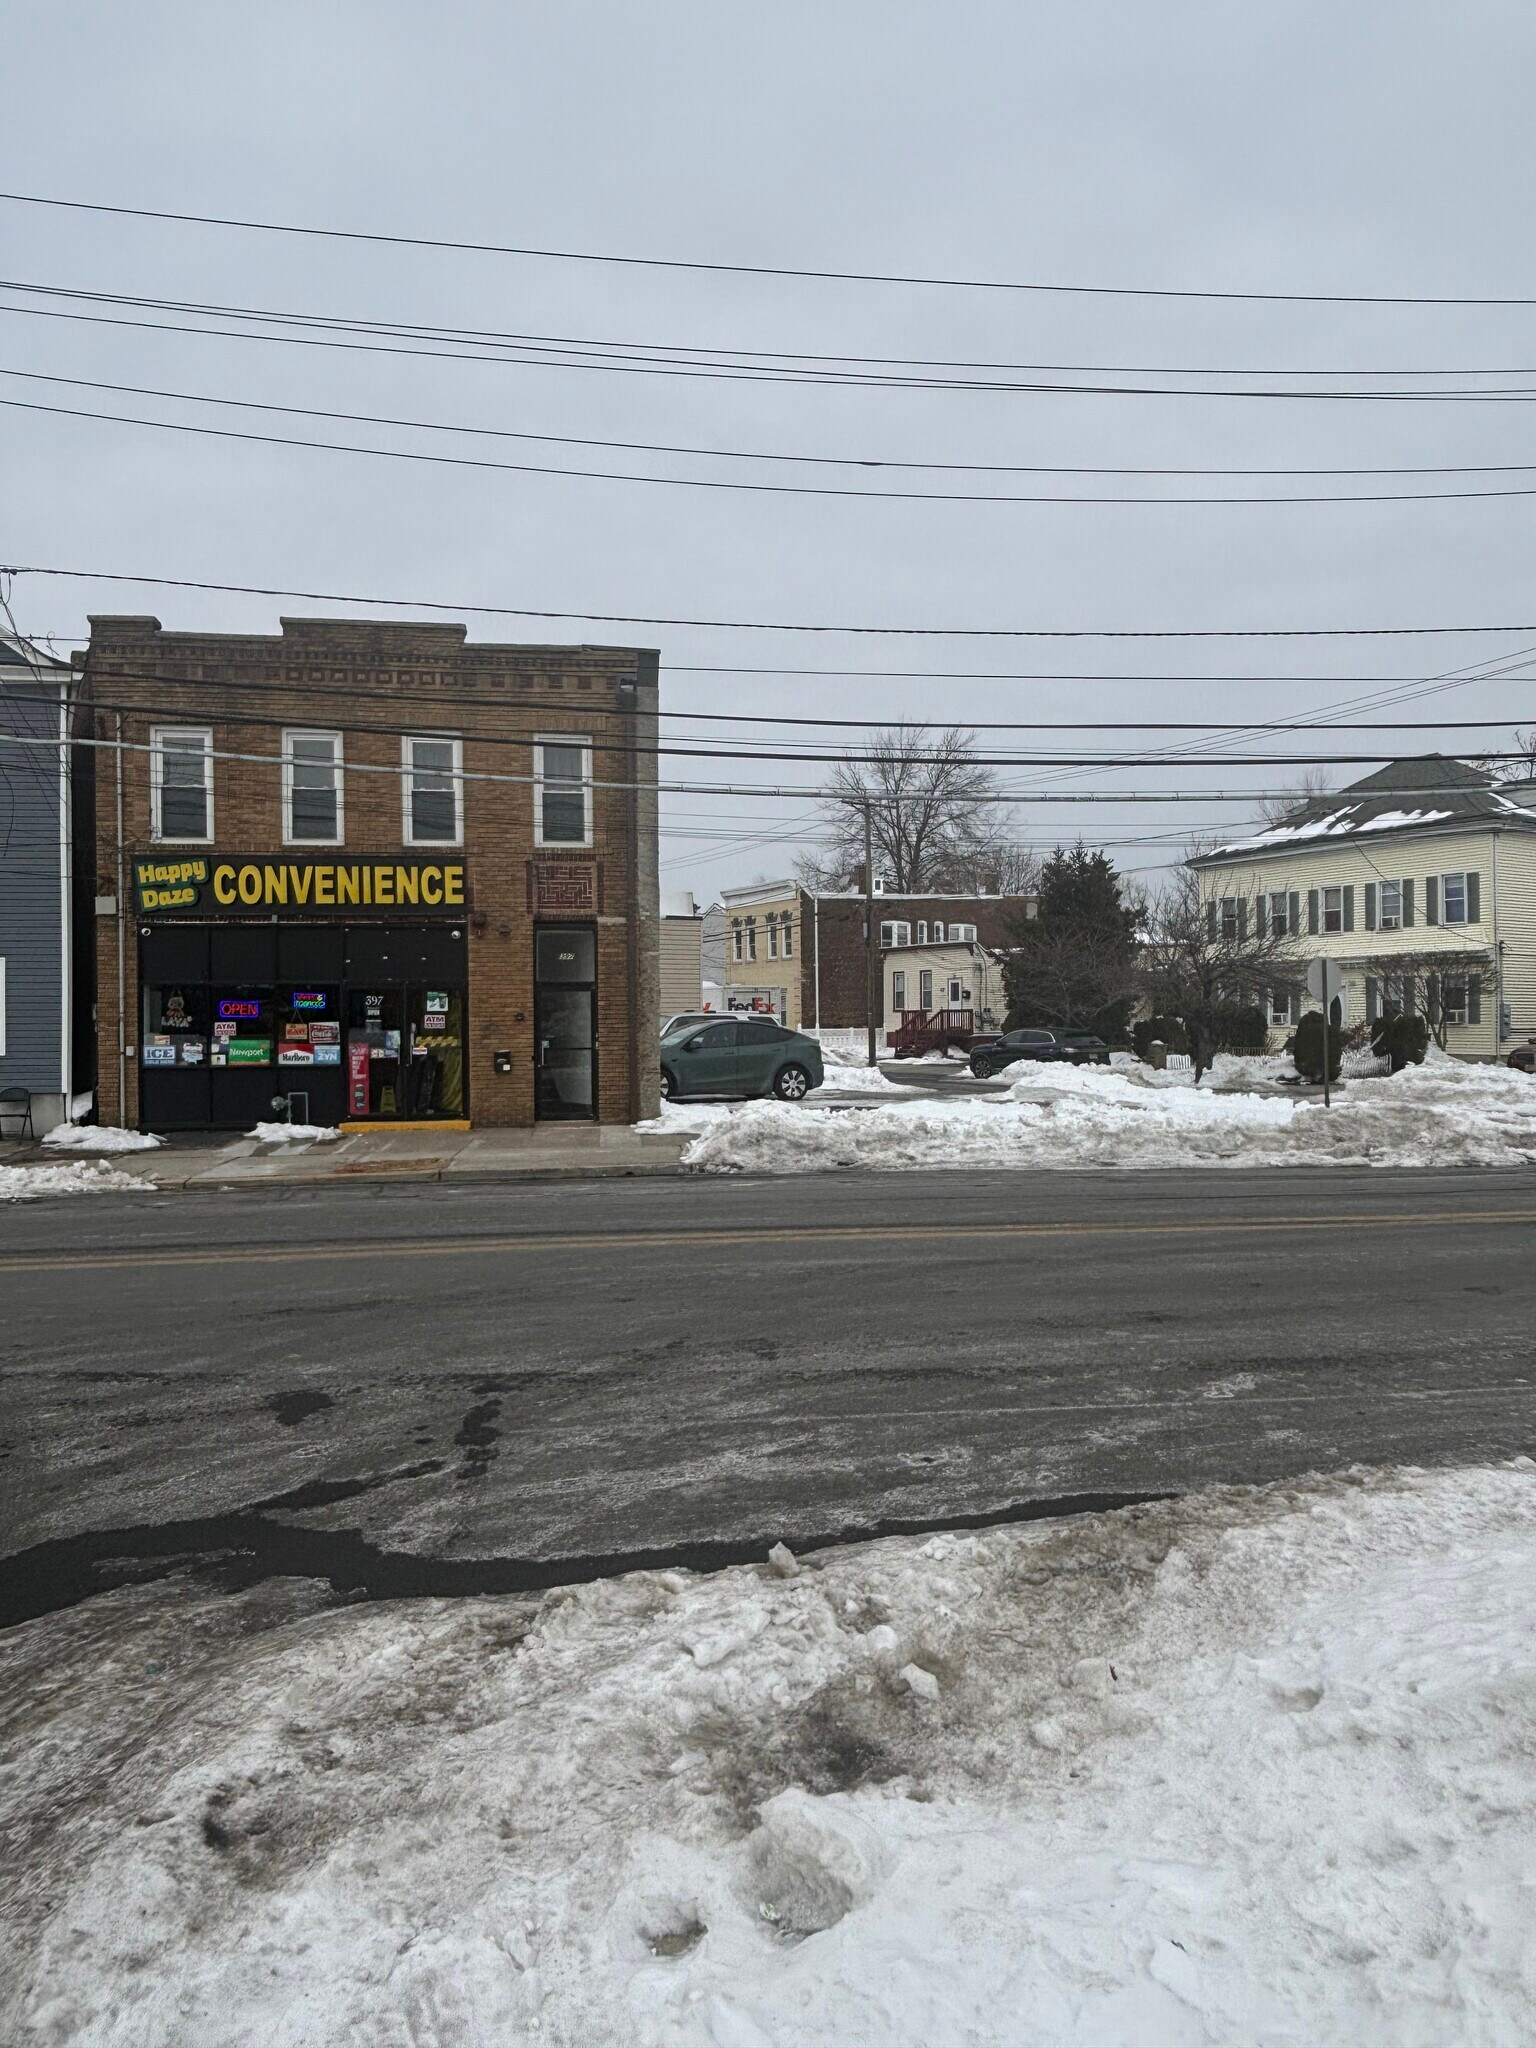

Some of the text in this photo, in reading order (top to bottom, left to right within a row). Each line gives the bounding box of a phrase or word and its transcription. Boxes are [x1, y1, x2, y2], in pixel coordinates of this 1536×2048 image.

[138, 861, 205, 883] Happy
[213, 865, 465, 905] CONVENIENCE
[142, 887, 195, 908] Daze
[365, 995, 384, 1006] 397
[728, 997, 776, 1014] FedEx
[221, 1003, 257, 1015] OPEN
[146, 1048, 173, 1058] ICE
[229, 1048, 264, 1057] Newport
[282, 1052, 310, 1062] Marlboro
[318, 1052, 337, 1060] ZYN
